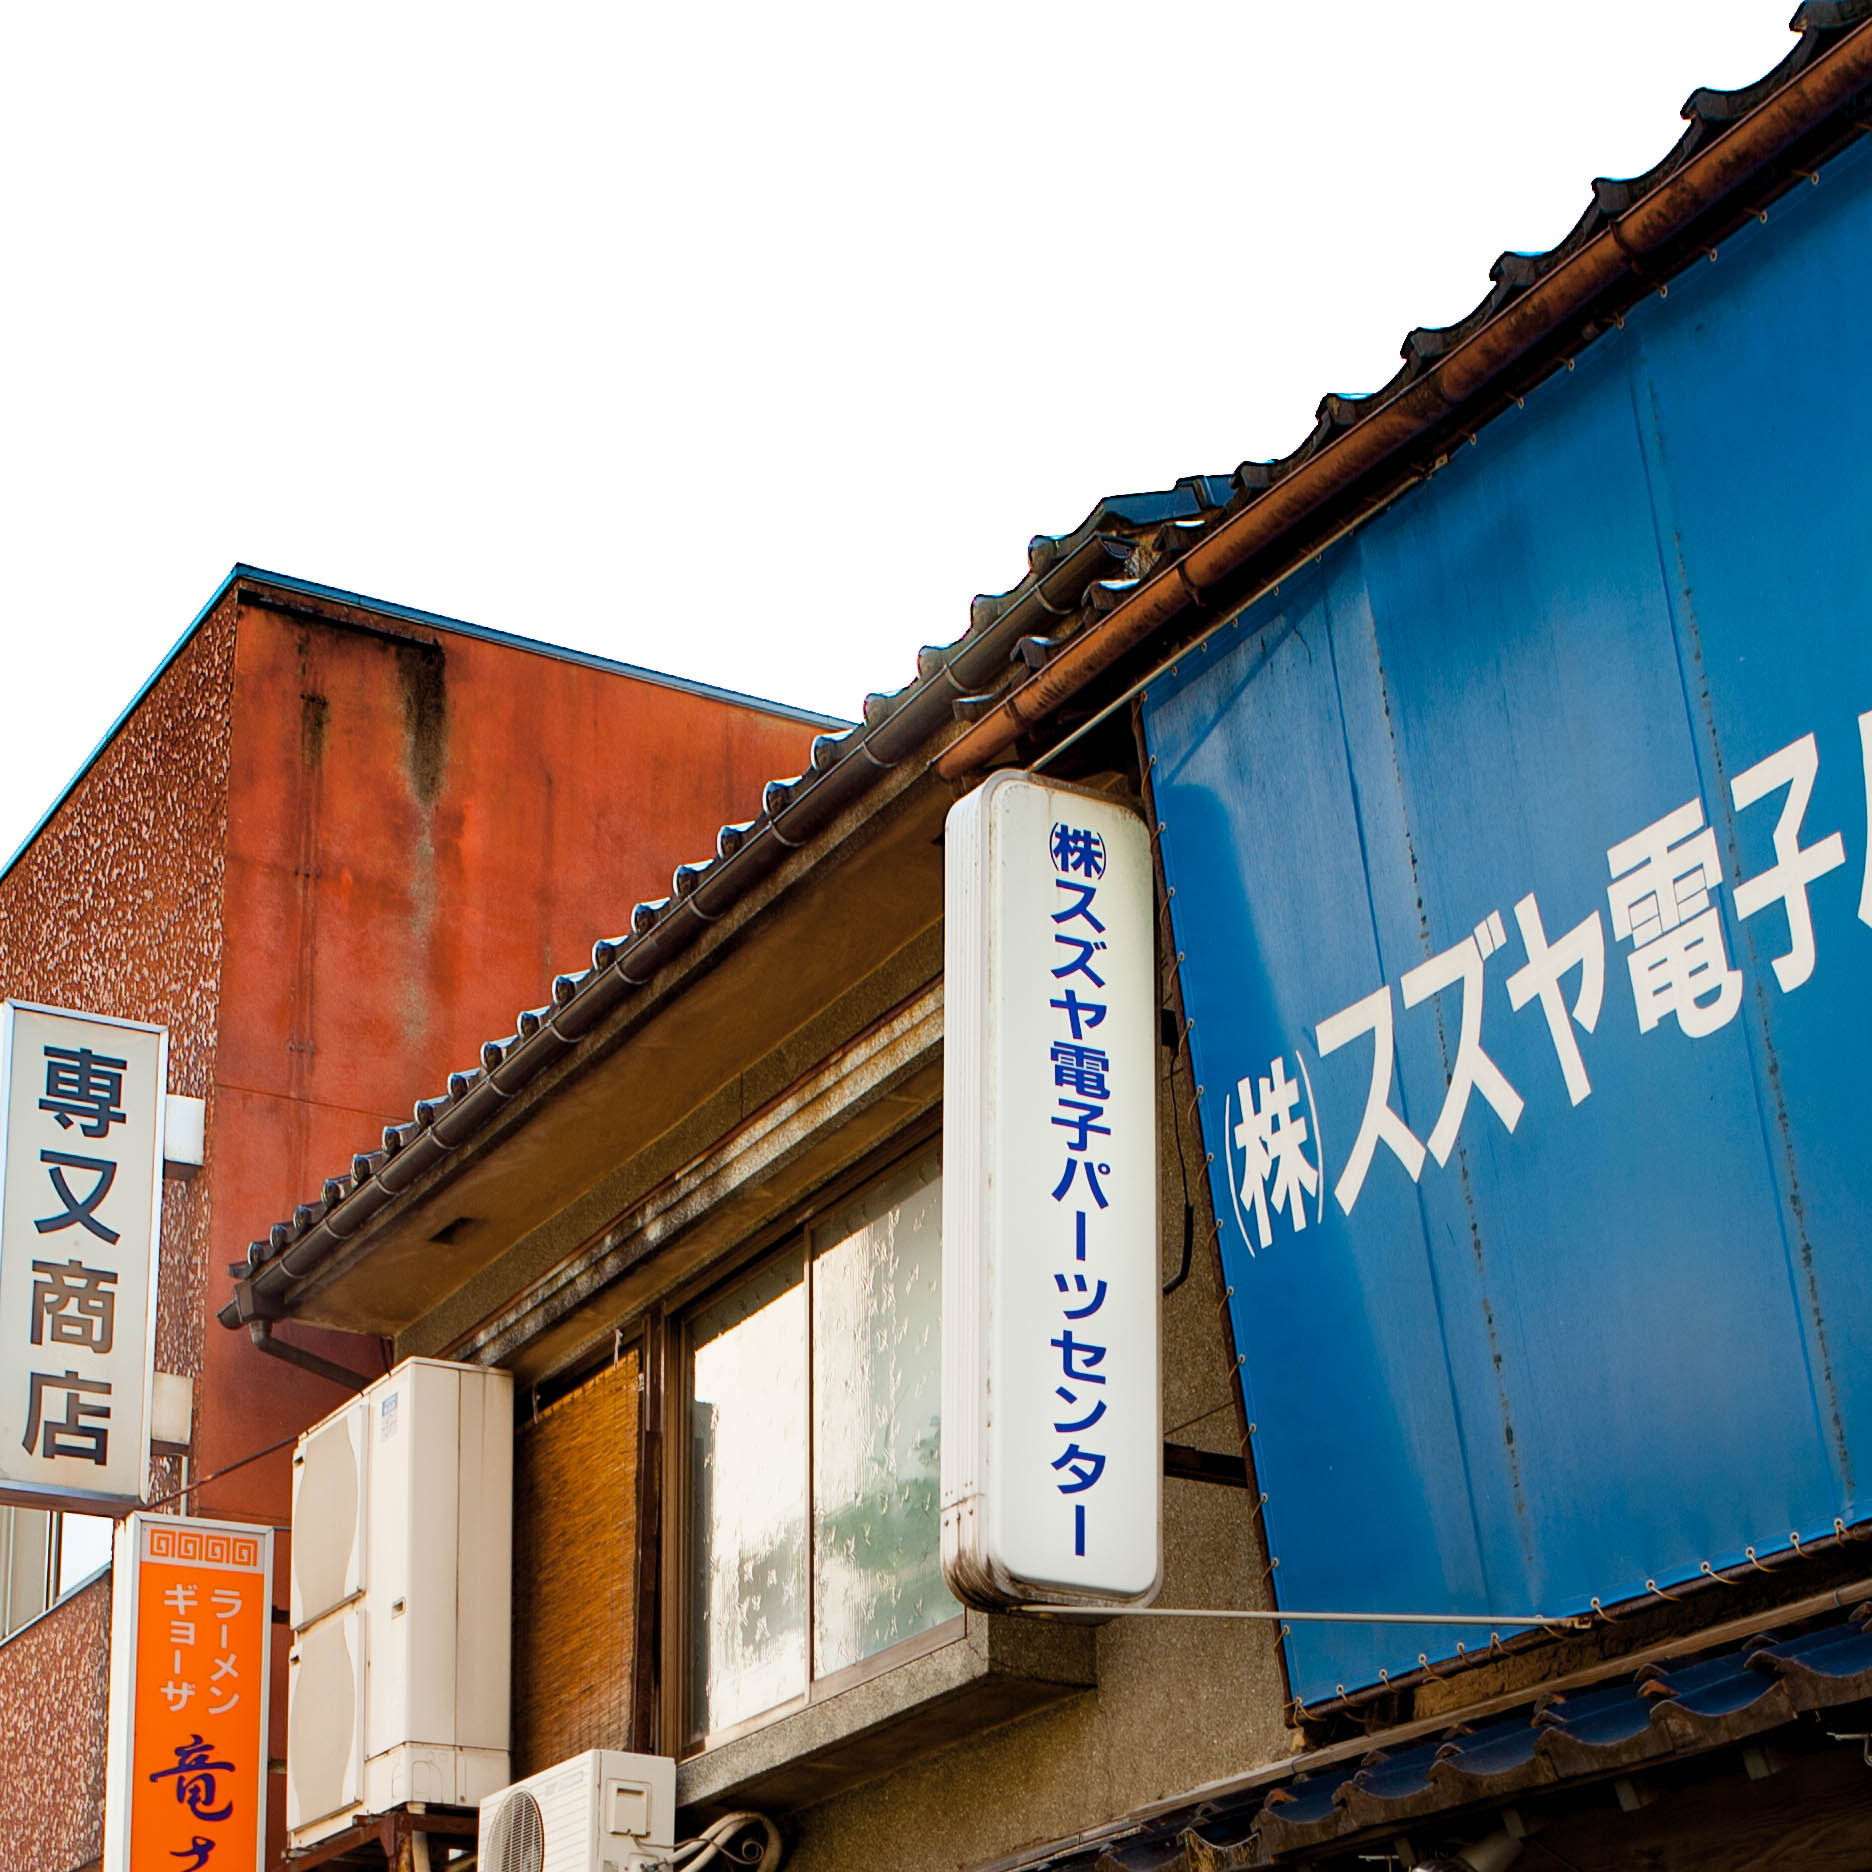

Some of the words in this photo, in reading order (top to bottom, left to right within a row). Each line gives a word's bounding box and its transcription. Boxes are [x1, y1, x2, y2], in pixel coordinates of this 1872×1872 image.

[22, 1045, 127, 1466] 専又商店
[160, 1583, 198, 1712] ギョーザ
[209, 1588, 242, 1714] ラーメン
